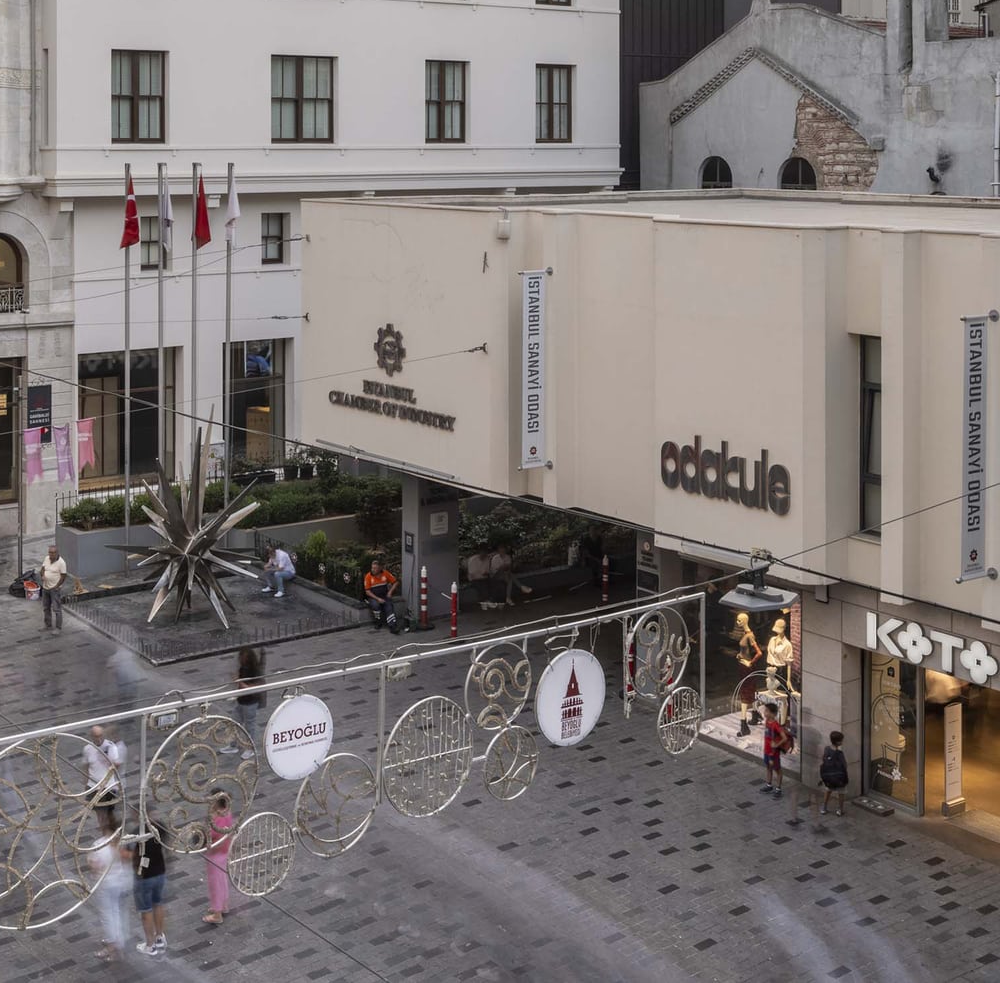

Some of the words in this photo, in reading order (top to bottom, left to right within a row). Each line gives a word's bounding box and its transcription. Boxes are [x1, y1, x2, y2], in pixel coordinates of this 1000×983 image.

[528, 276, 542, 339] İSTANBUL
[527, 342, 542, 391] SANAYİ
[968, 322, 985, 408] İSTANBUL
[328, 390, 382, 416] CHAMBER
[382, 401, 398, 419] OF
[397, 404, 457, 432] INDUSTRY
[527, 394, 539, 434] ODASI
[967, 411, 984, 475] SANAYİ
[661, 435, 791, 516] odakule
[967, 481, 981, 533] ODASI
[272, 722, 327, 745] BEYOĞLU
